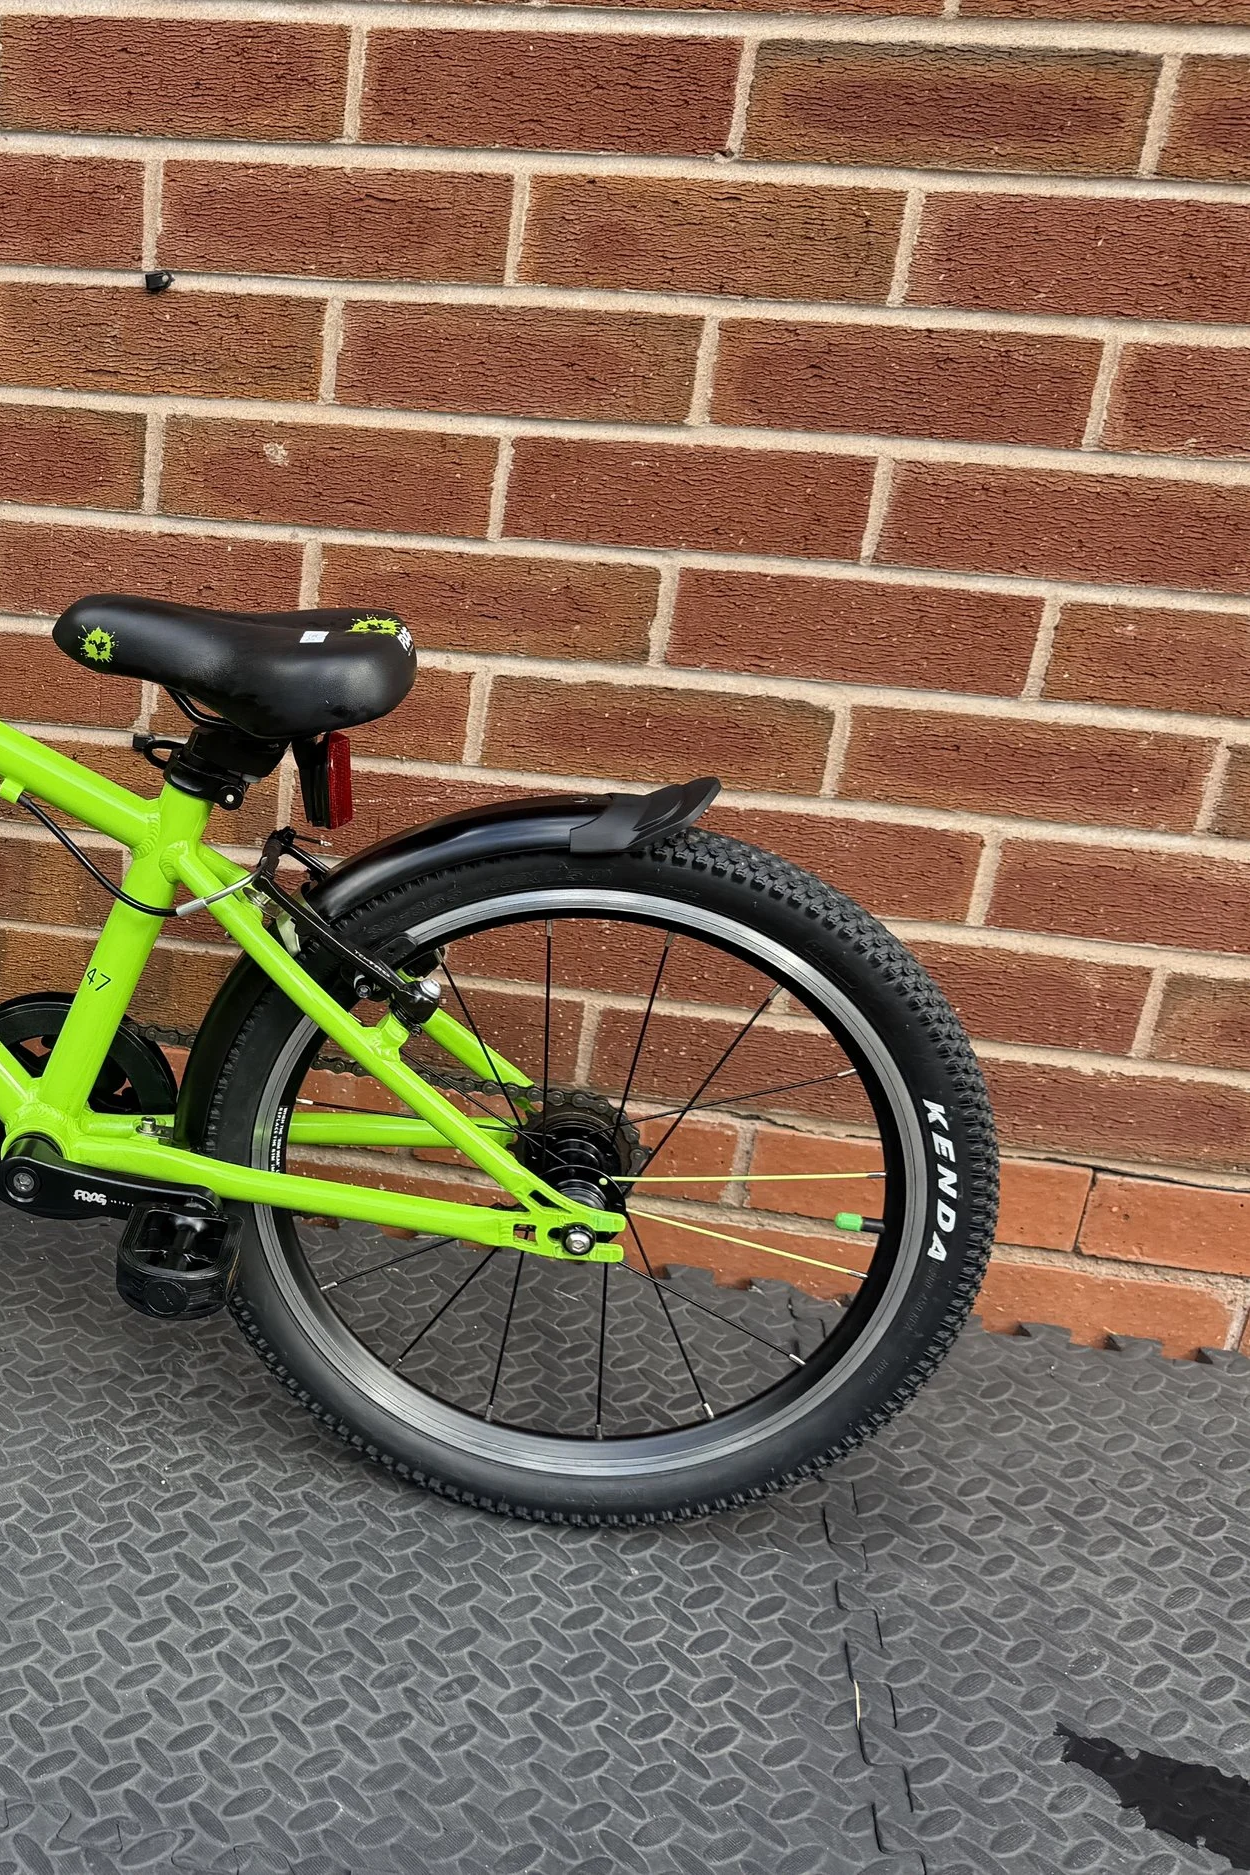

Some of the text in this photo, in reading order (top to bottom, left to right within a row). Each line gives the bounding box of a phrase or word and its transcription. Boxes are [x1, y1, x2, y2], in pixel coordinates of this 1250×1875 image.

[86, 967, 112, 992] 47
[922, 1098, 958, 1262] KENDA
[73, 1189, 108, 1206] FROG
